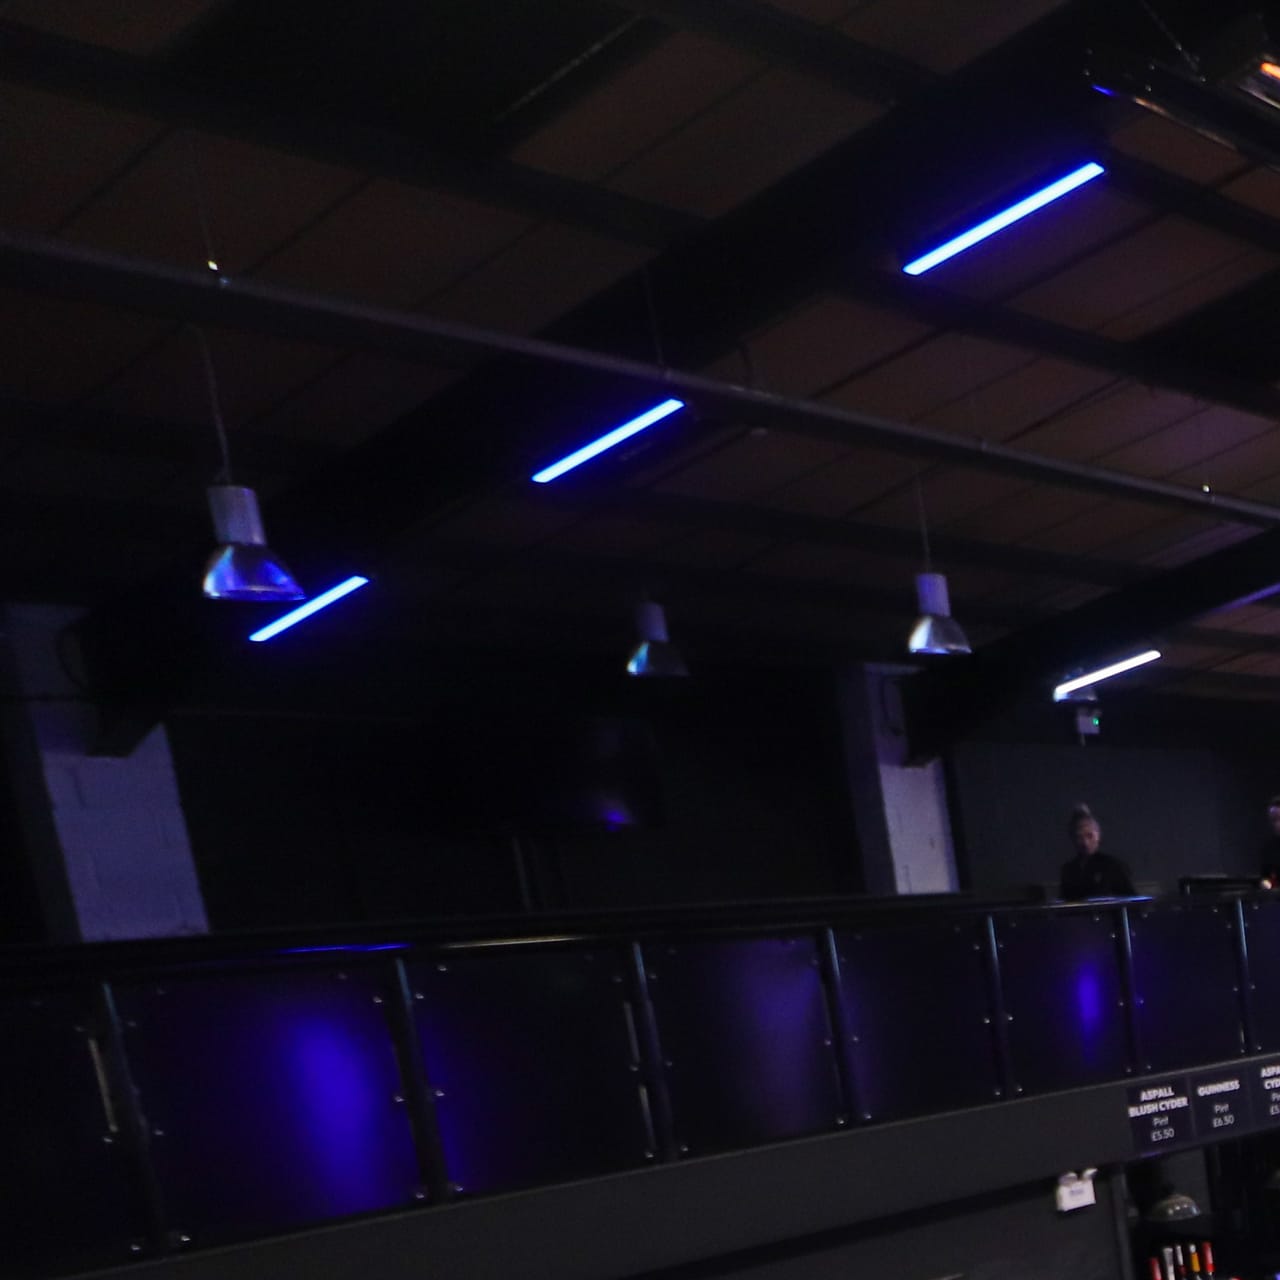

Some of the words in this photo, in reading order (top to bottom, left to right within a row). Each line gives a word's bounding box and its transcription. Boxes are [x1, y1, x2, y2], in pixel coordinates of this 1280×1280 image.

[1140, 1086, 1175, 1101] ASPALL
[1197, 1080, 1240, 1097] GUINNESS
[1128, 1100, 1158, 1118] BLUSH
[1159, 1096, 1188, 1112] CYDER
[1213, 1114, 1235, 1128] £6.50
[1152, 1127, 1175, 1142] £5.50
